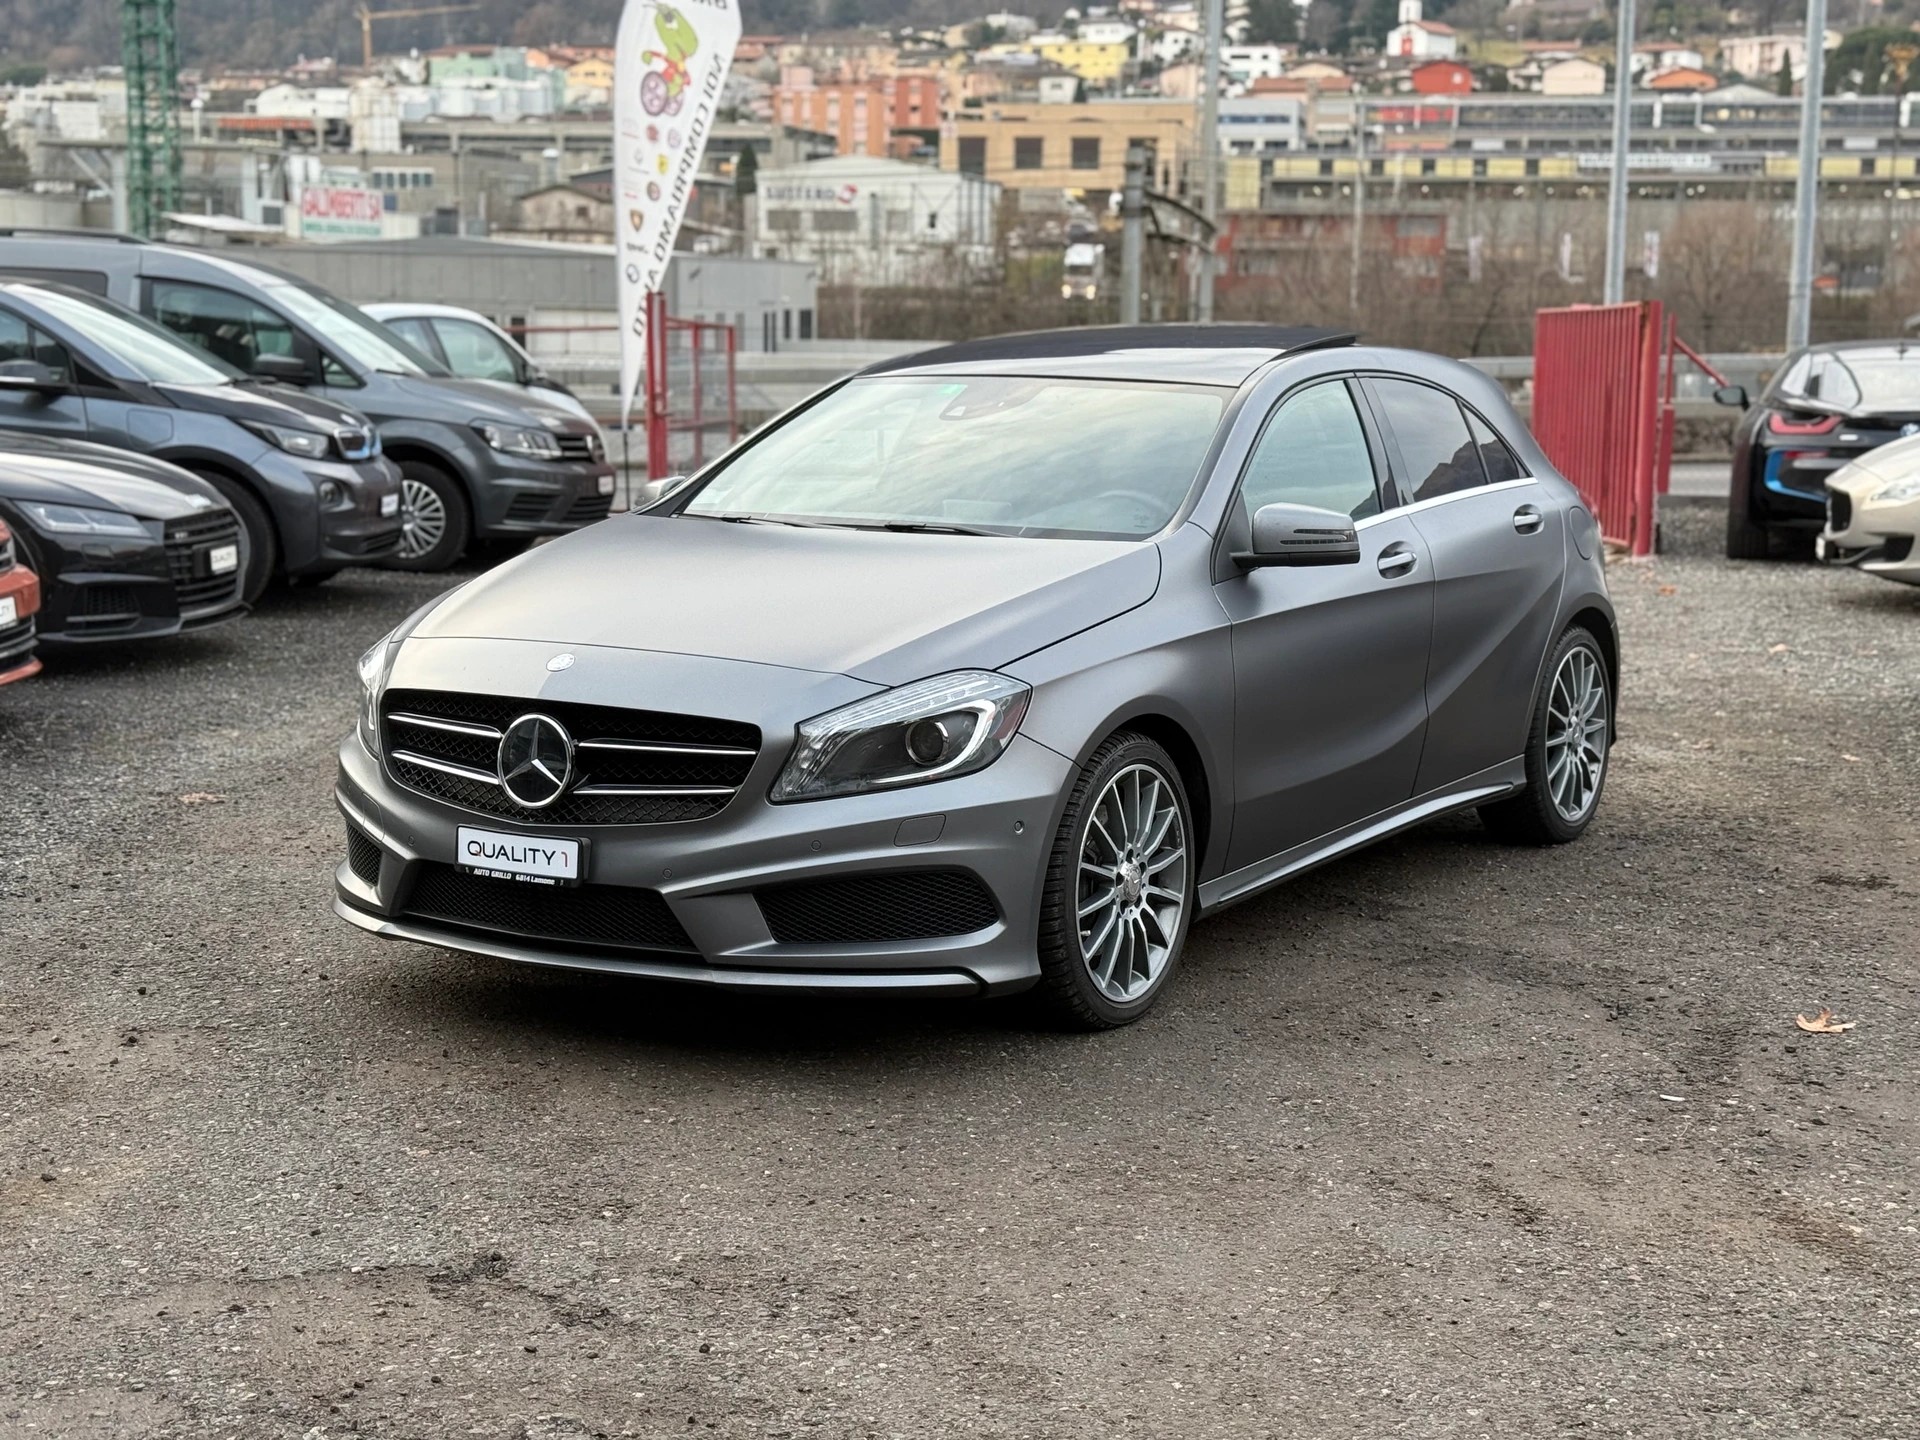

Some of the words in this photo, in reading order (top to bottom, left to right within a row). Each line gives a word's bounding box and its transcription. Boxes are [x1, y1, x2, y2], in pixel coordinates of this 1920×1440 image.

[467, 840, 556, 866] QUALITY
[561, 851, 568, 868] 1
[473, 868, 490, 877] AUTO
[491, 870, 512, 880] GRILLO
[515, 874, 531, 882] 6814
